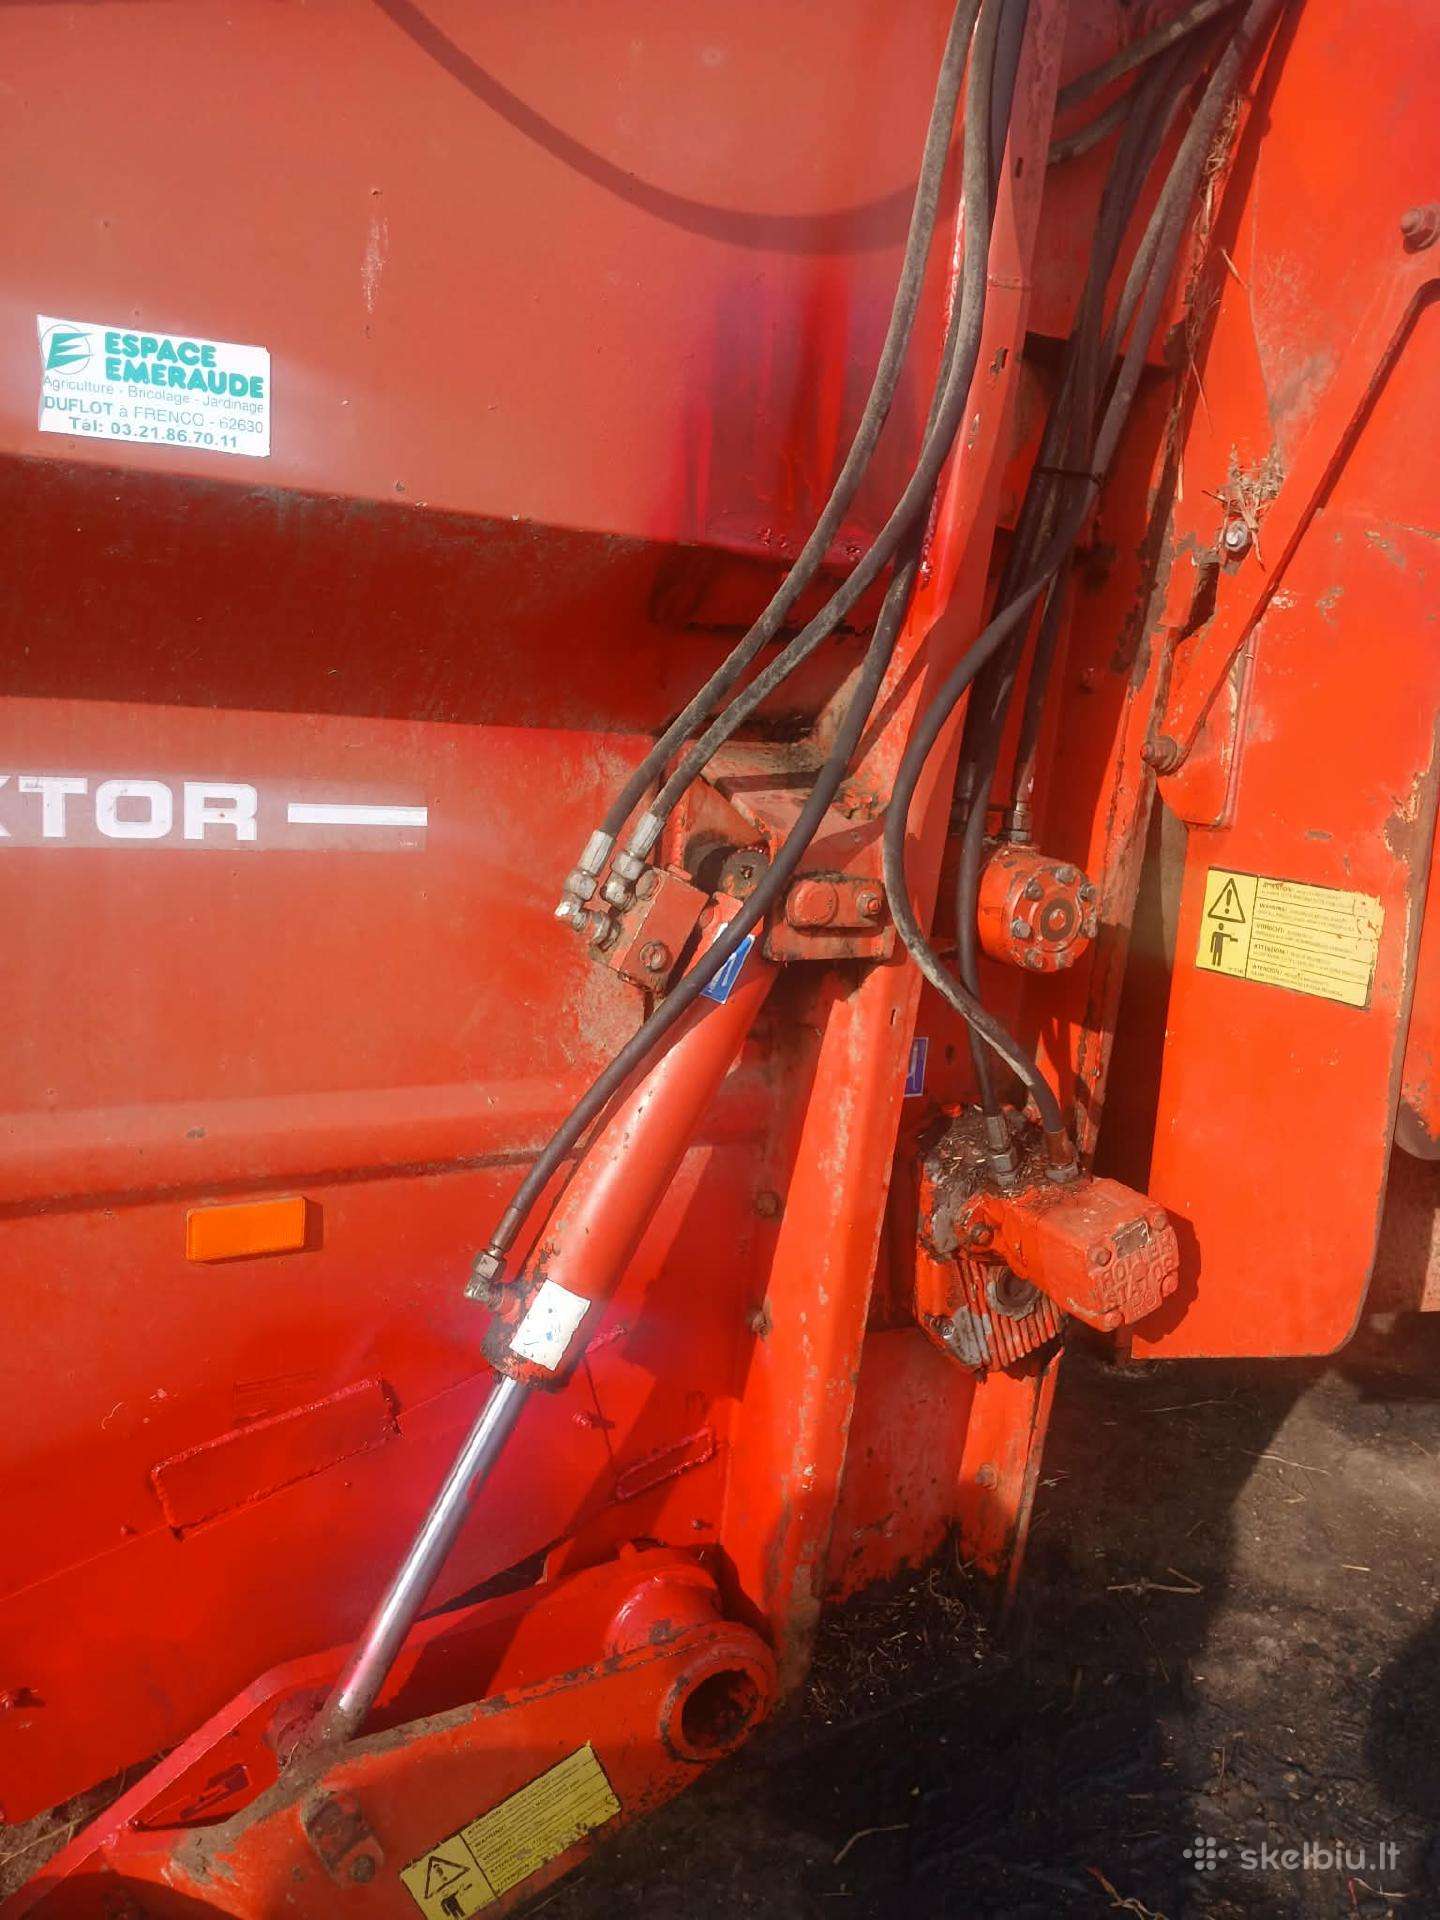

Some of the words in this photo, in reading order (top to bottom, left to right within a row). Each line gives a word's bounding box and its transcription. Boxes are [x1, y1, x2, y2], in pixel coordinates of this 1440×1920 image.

[105, 332, 217, 368] ESPACE
[44, 376, 114, 396] Agriculture
[128, 386, 190, 405] Bricolage
[203, 396, 264, 414] Jardinage
[105, 357, 264, 398] EMERAUDE
[45, 396, 112, 415] DUFLOT
[219, 417, 263, 434] 62630
[111, 422, 237, 448] 03.21.86.70.11
[0, 775, 257, 841] TOR
